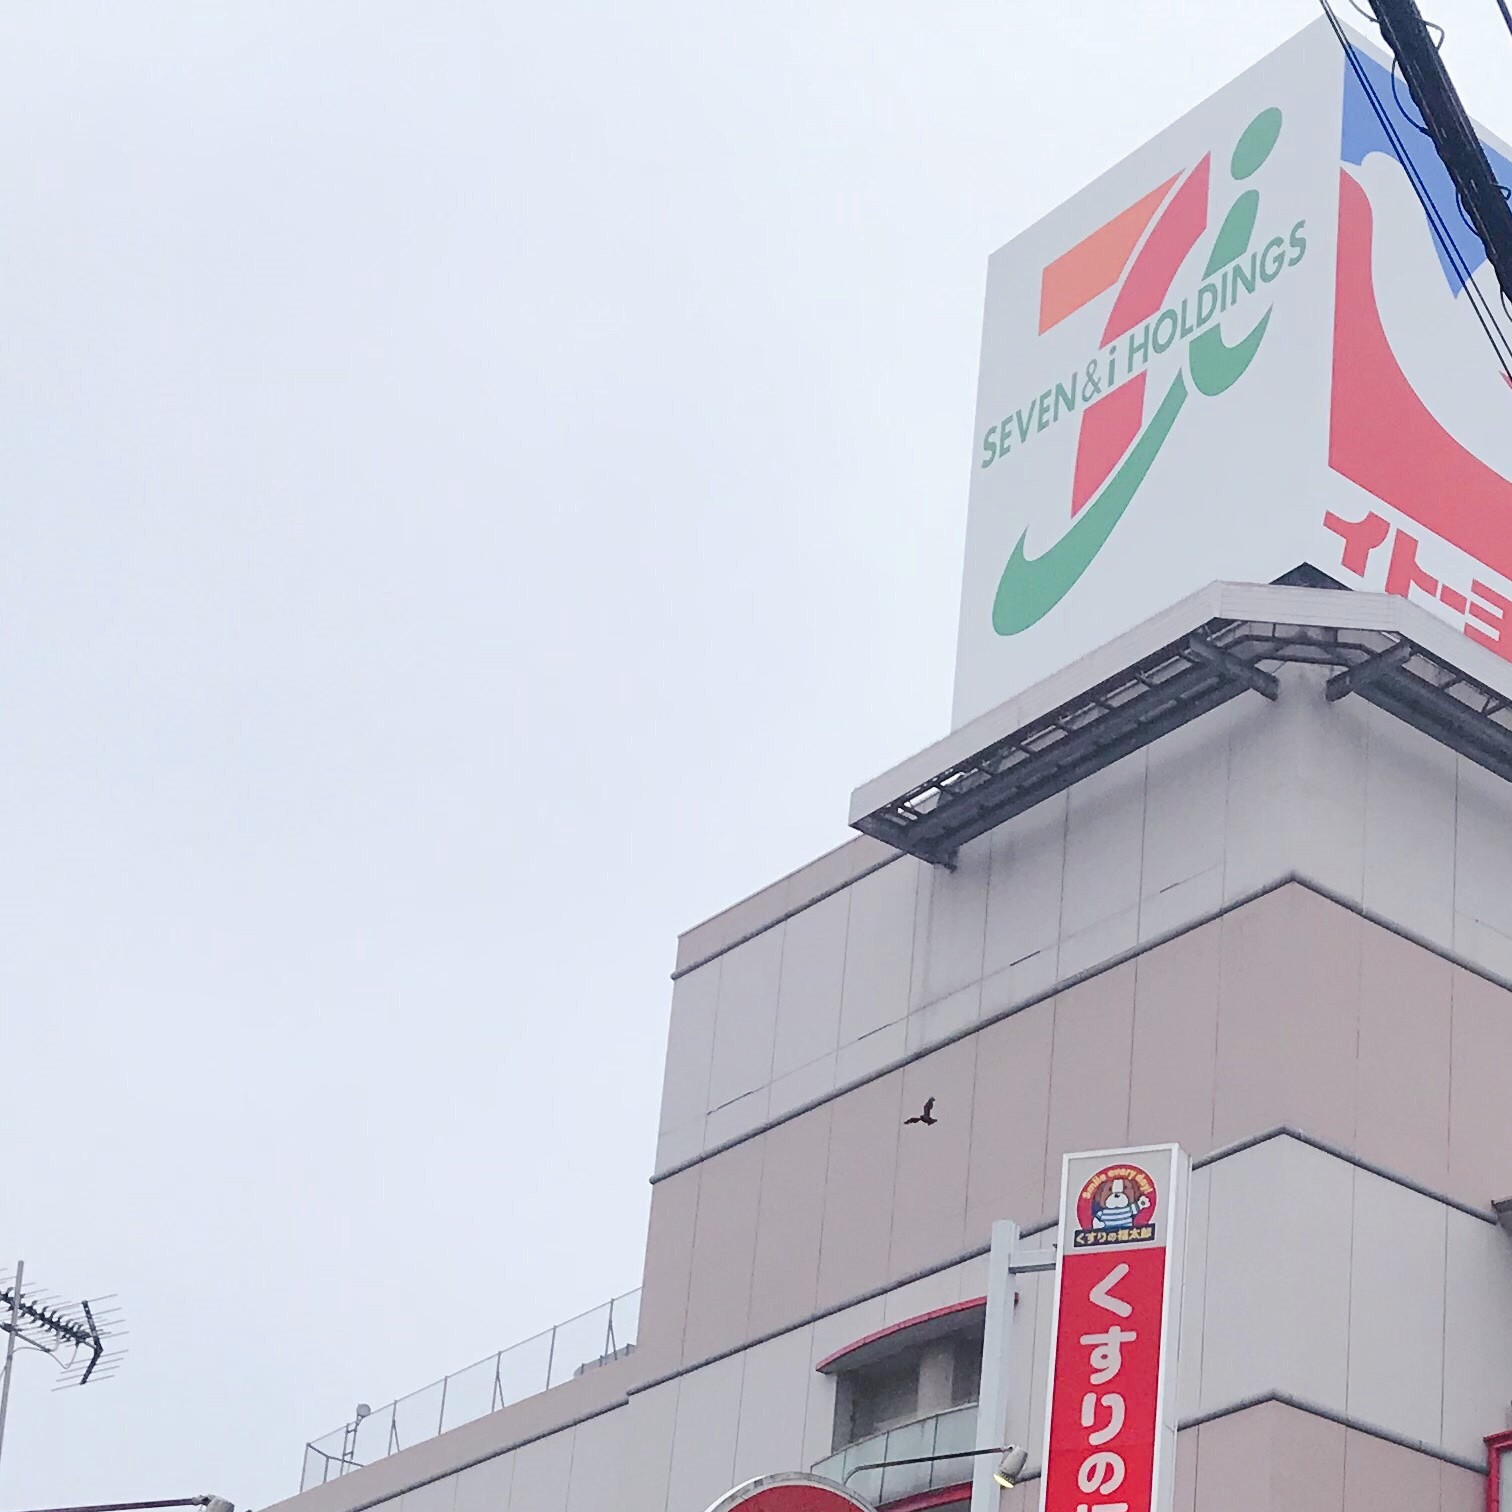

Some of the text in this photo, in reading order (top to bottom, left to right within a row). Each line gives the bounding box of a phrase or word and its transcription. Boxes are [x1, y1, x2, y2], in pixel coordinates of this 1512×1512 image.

[981, 379, 1078, 470] SEVEN
[1081, 357, 1105, 404] &
[1127, 219, 1308, 376] HOLDINGS
